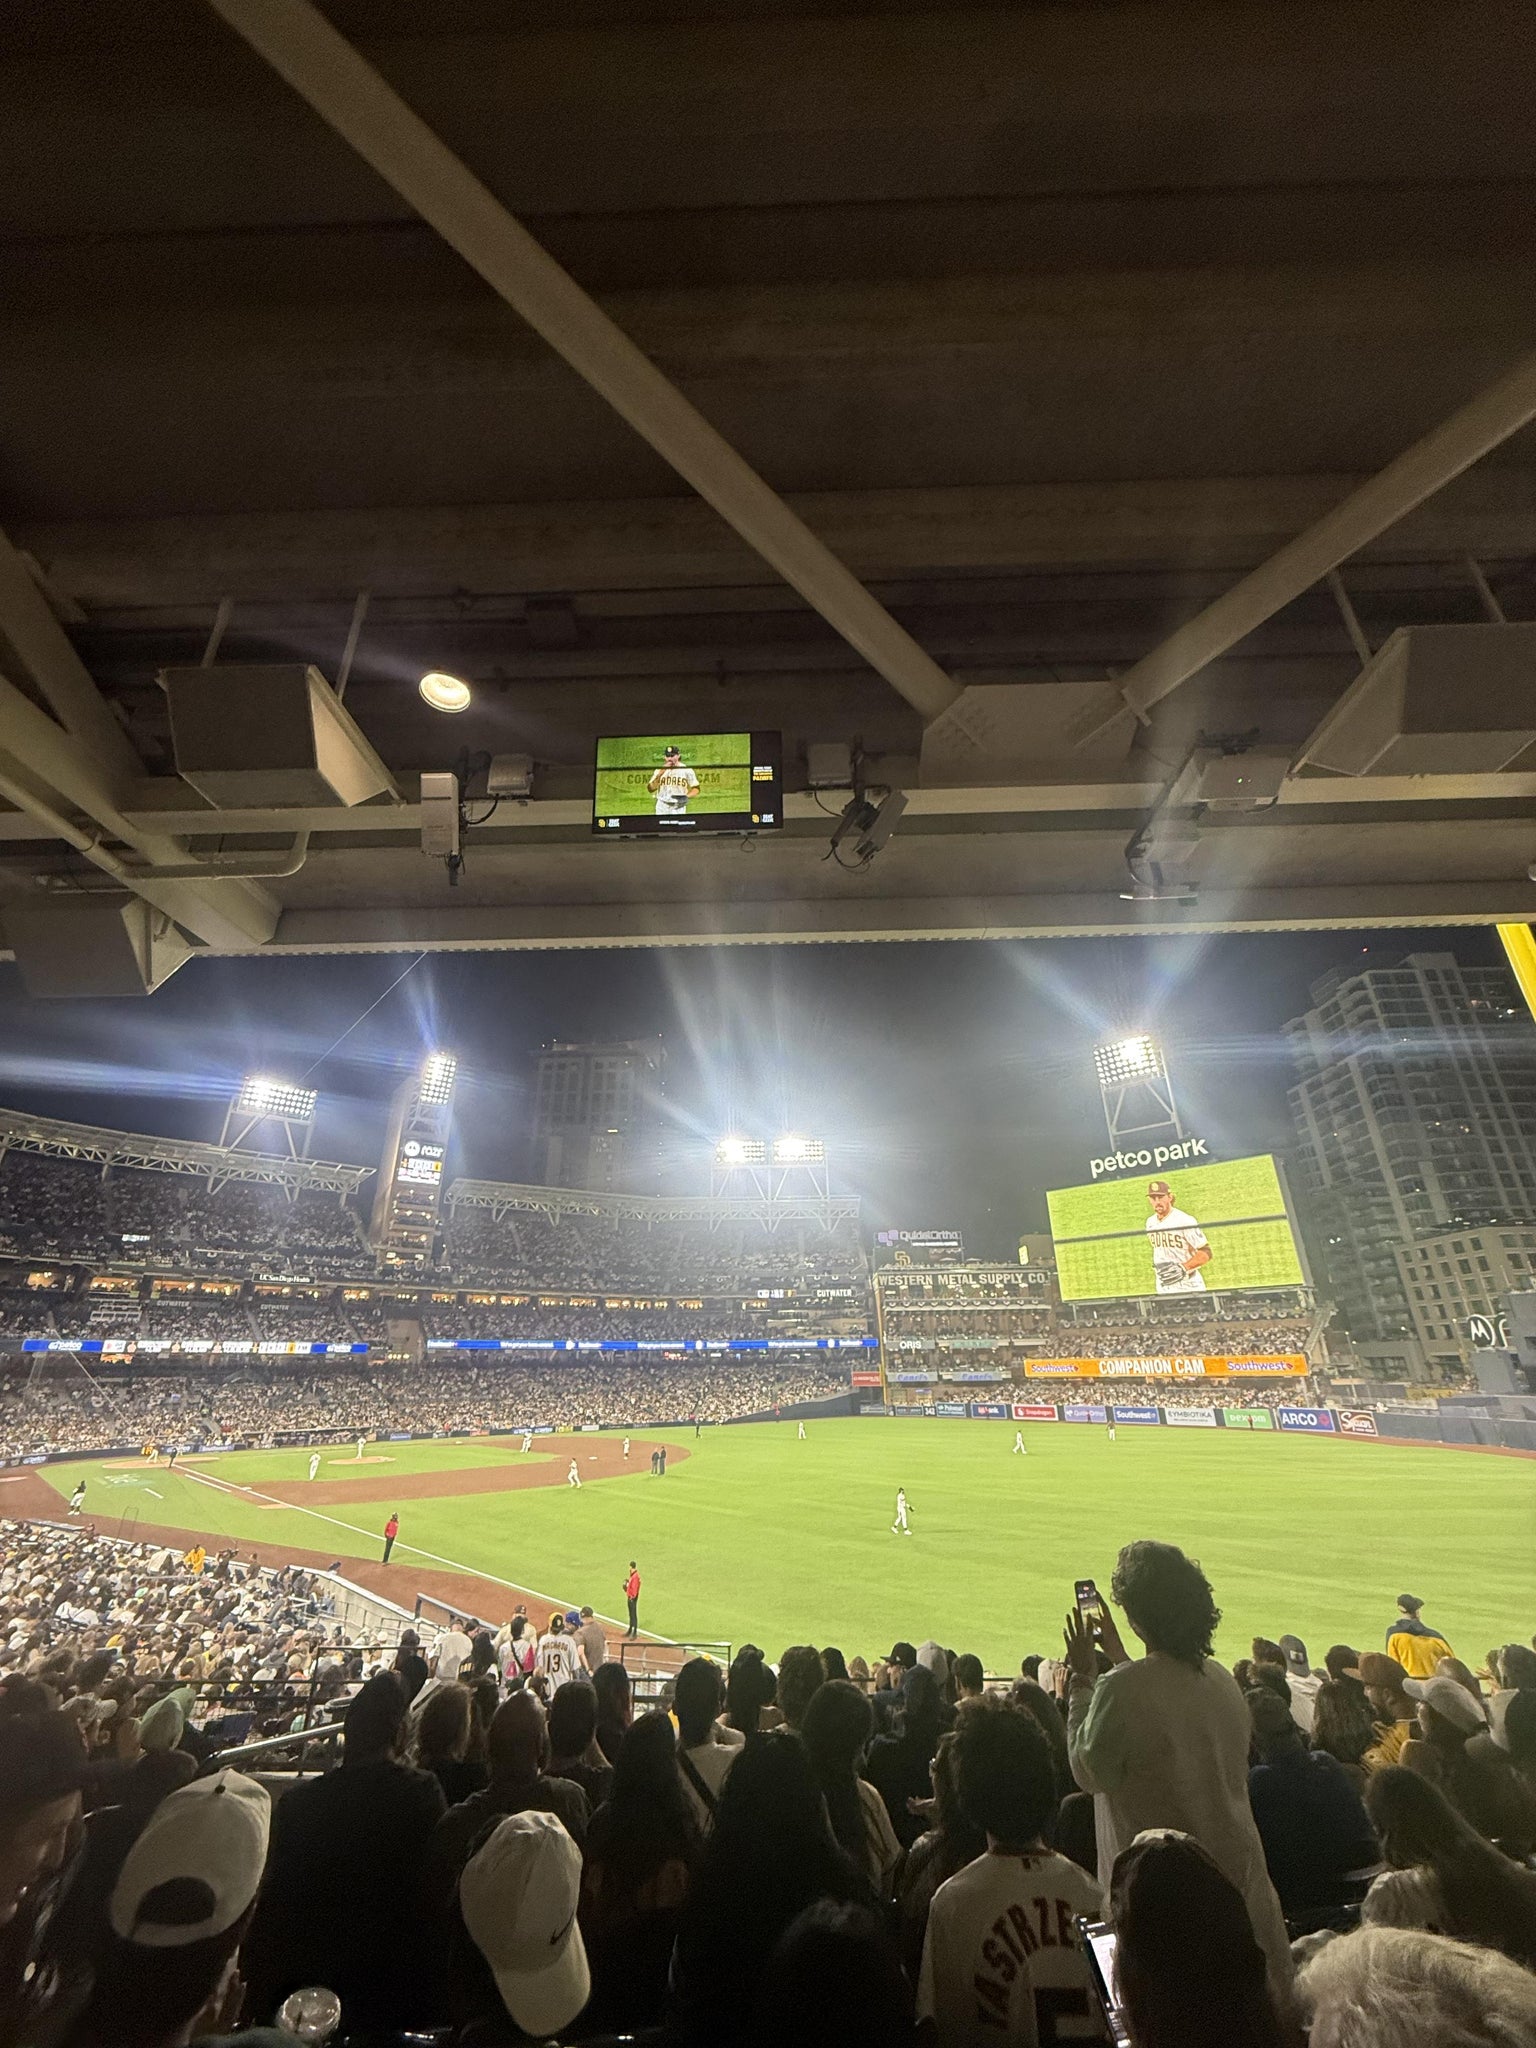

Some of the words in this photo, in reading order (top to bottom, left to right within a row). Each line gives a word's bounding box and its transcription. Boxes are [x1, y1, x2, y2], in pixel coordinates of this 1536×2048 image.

[658, 776, 686, 787] ADRES
[1090, 1151, 1152, 1178] petco
[1154, 1139, 1209, 1167] park
[1151, 1233, 1184, 1249] ADRES
[878, 1274, 933, 1286] WESTERN
[938, 1274, 974, 1286] METAL
[979, 1273, 1024, 1285] SUPPLY
[817, 1289, 852, 1298] CUTWATER
[899, 1341, 922, 1349] ORIS
[1031, 1364, 1074, 1373] Southwest
[1098, 1358, 1172, 1375] COMPANION
[1174, 1358, 1206, 1374] CAM
[1227, 1359, 1287, 1372] Southwest
[1116, 1410, 1152, 1419] Southwest
[1282, 1412, 1318, 1426] ARCO
[547, 1653, 561, 1674] 13
[973, 1896, 1077, 2032] YASTRZE
